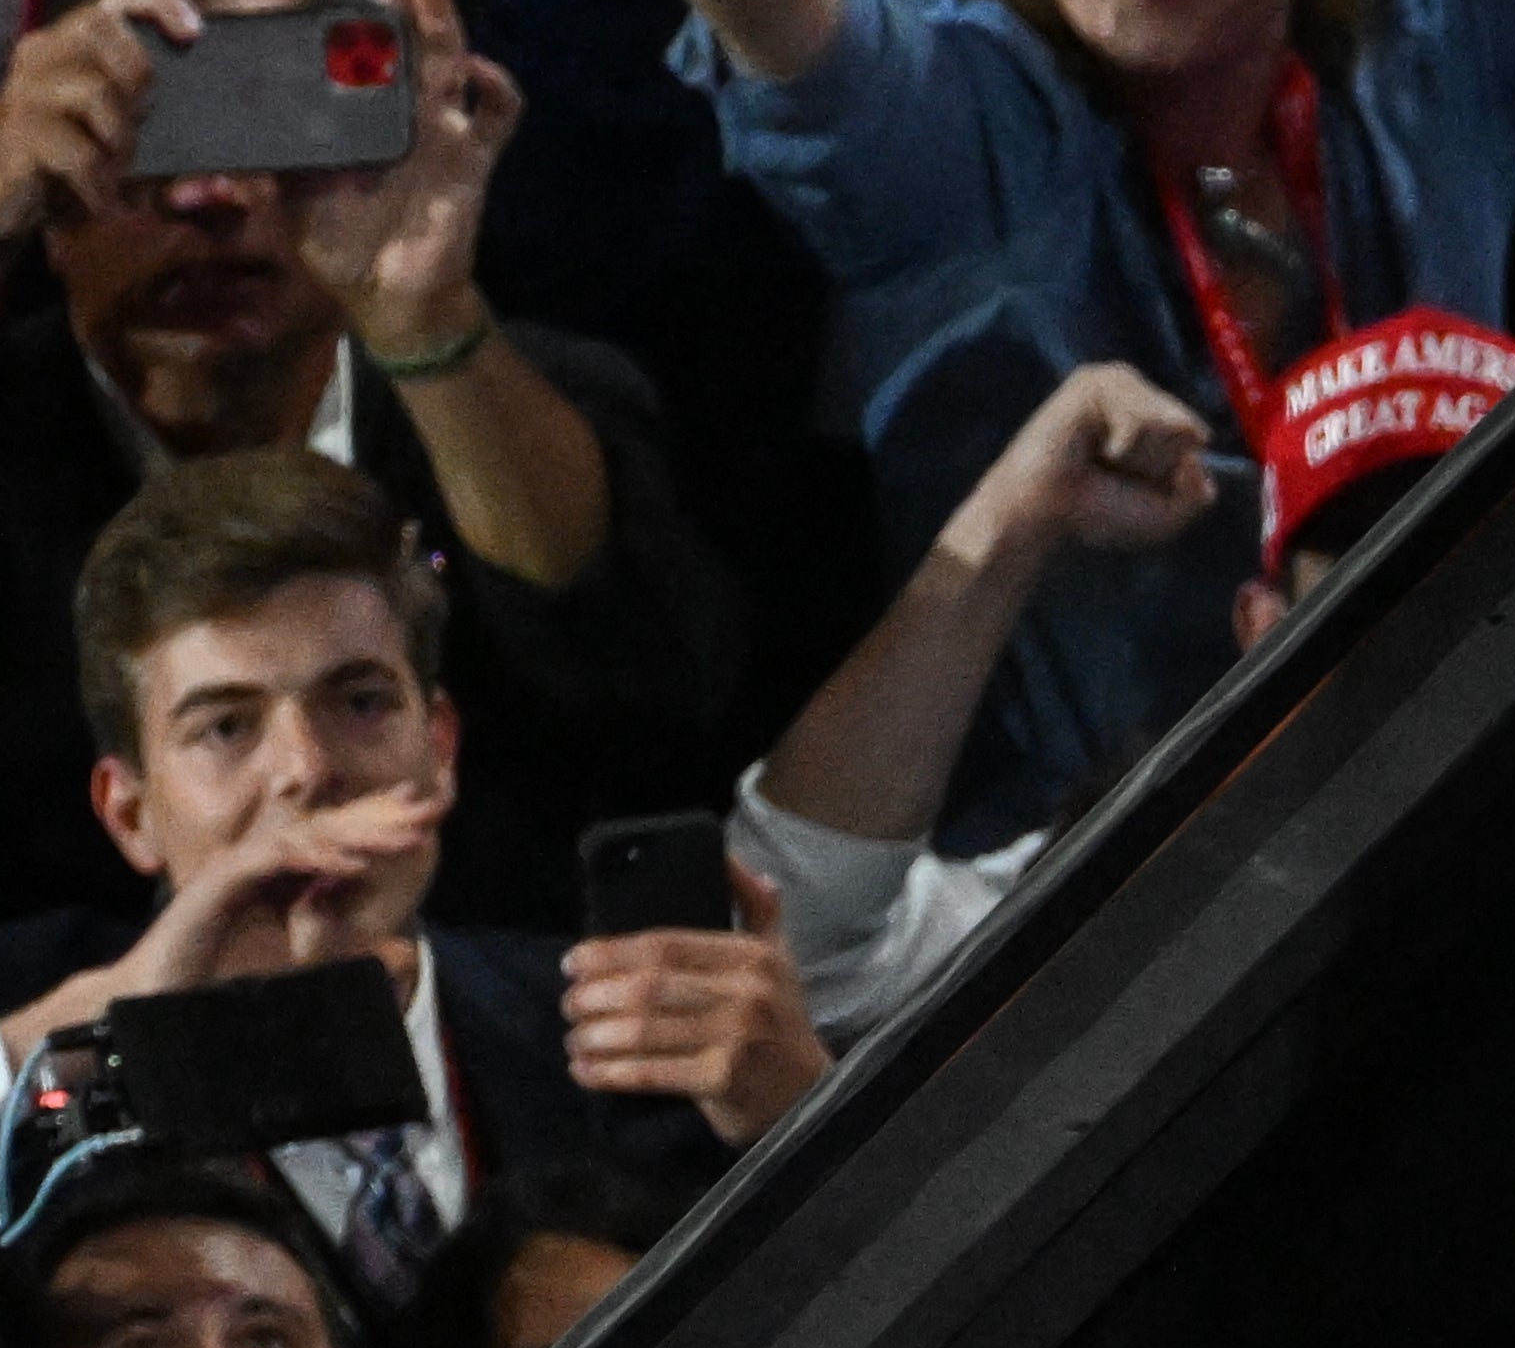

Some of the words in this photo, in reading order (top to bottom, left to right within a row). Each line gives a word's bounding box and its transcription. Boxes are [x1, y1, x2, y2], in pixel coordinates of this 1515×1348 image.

[1285, 339, 1389, 422] MAKE
[1304, 388, 1426, 469] GREAT
[1428, 390, 1488, 433] AG
